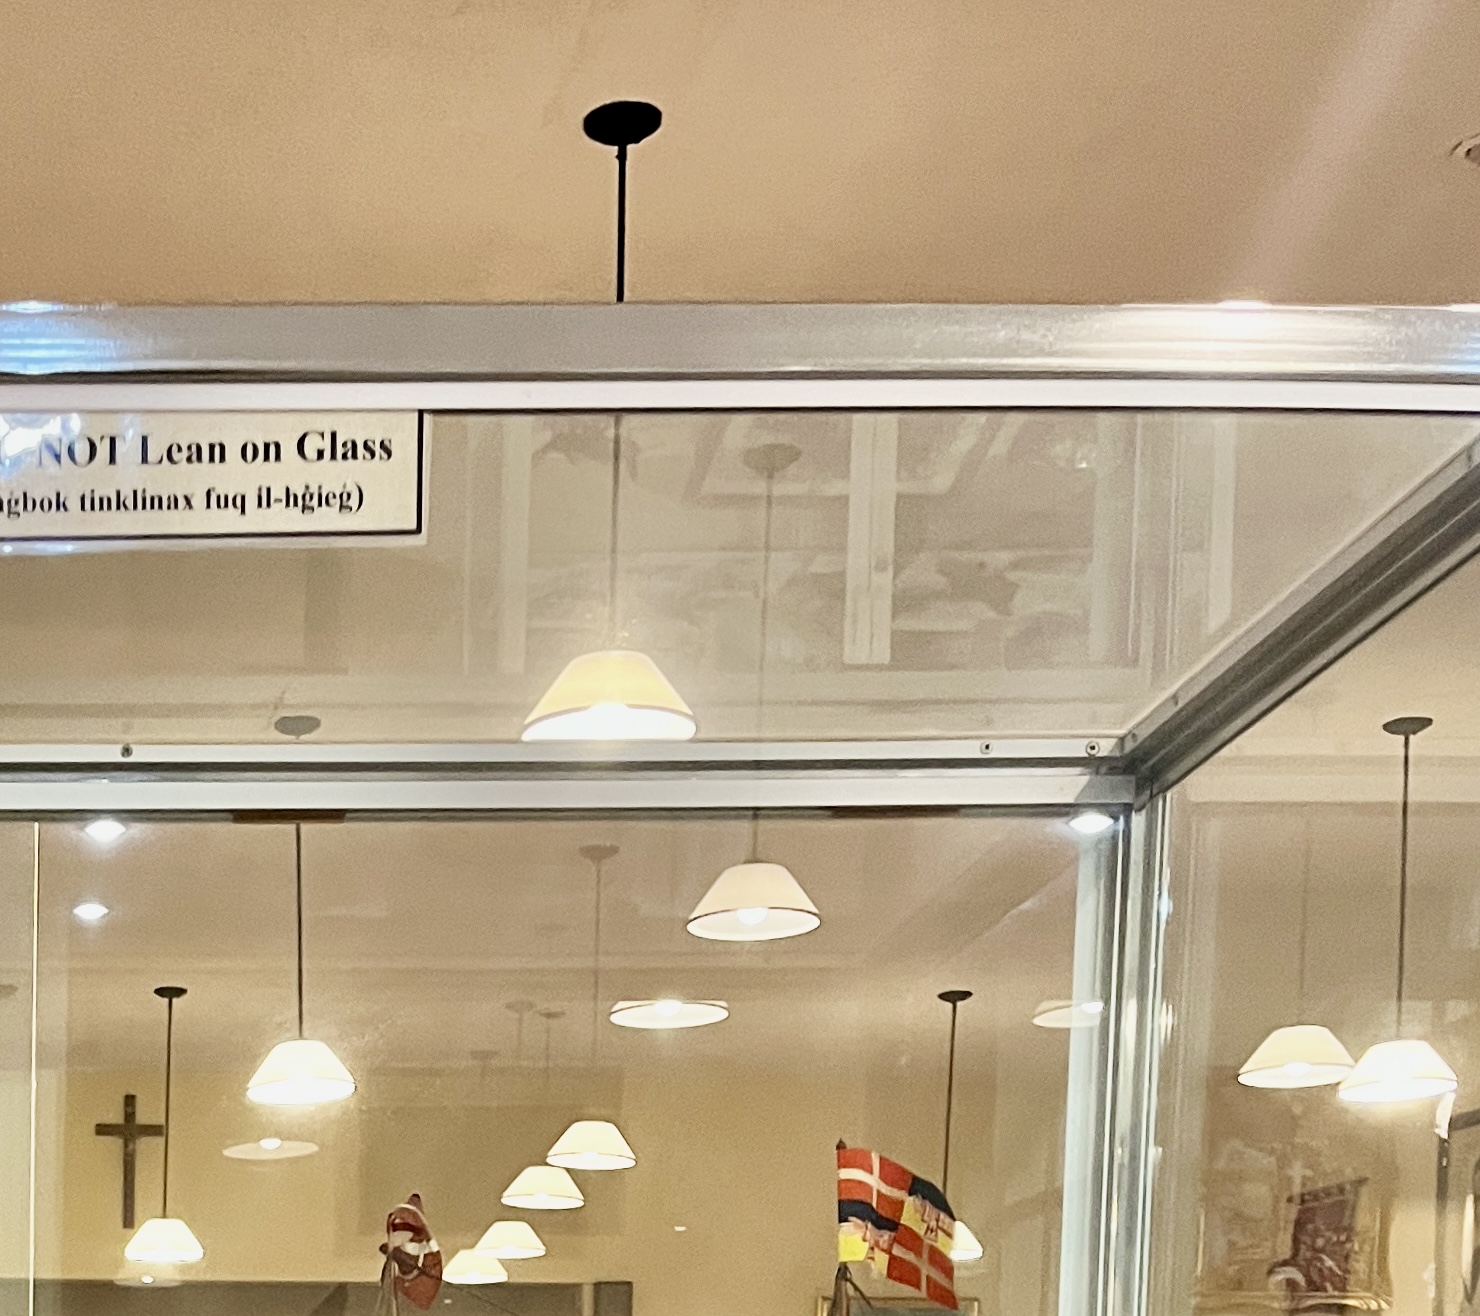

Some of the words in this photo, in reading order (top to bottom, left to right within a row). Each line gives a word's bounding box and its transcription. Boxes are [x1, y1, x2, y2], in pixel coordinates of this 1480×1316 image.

[140, 432, 226, 465] Lean
[240, 439, 282, 464] on
[296, 430, 393, 463] Glass
[79, 487, 194, 513] tinklinax
[205, 486, 247, 515] fuq
